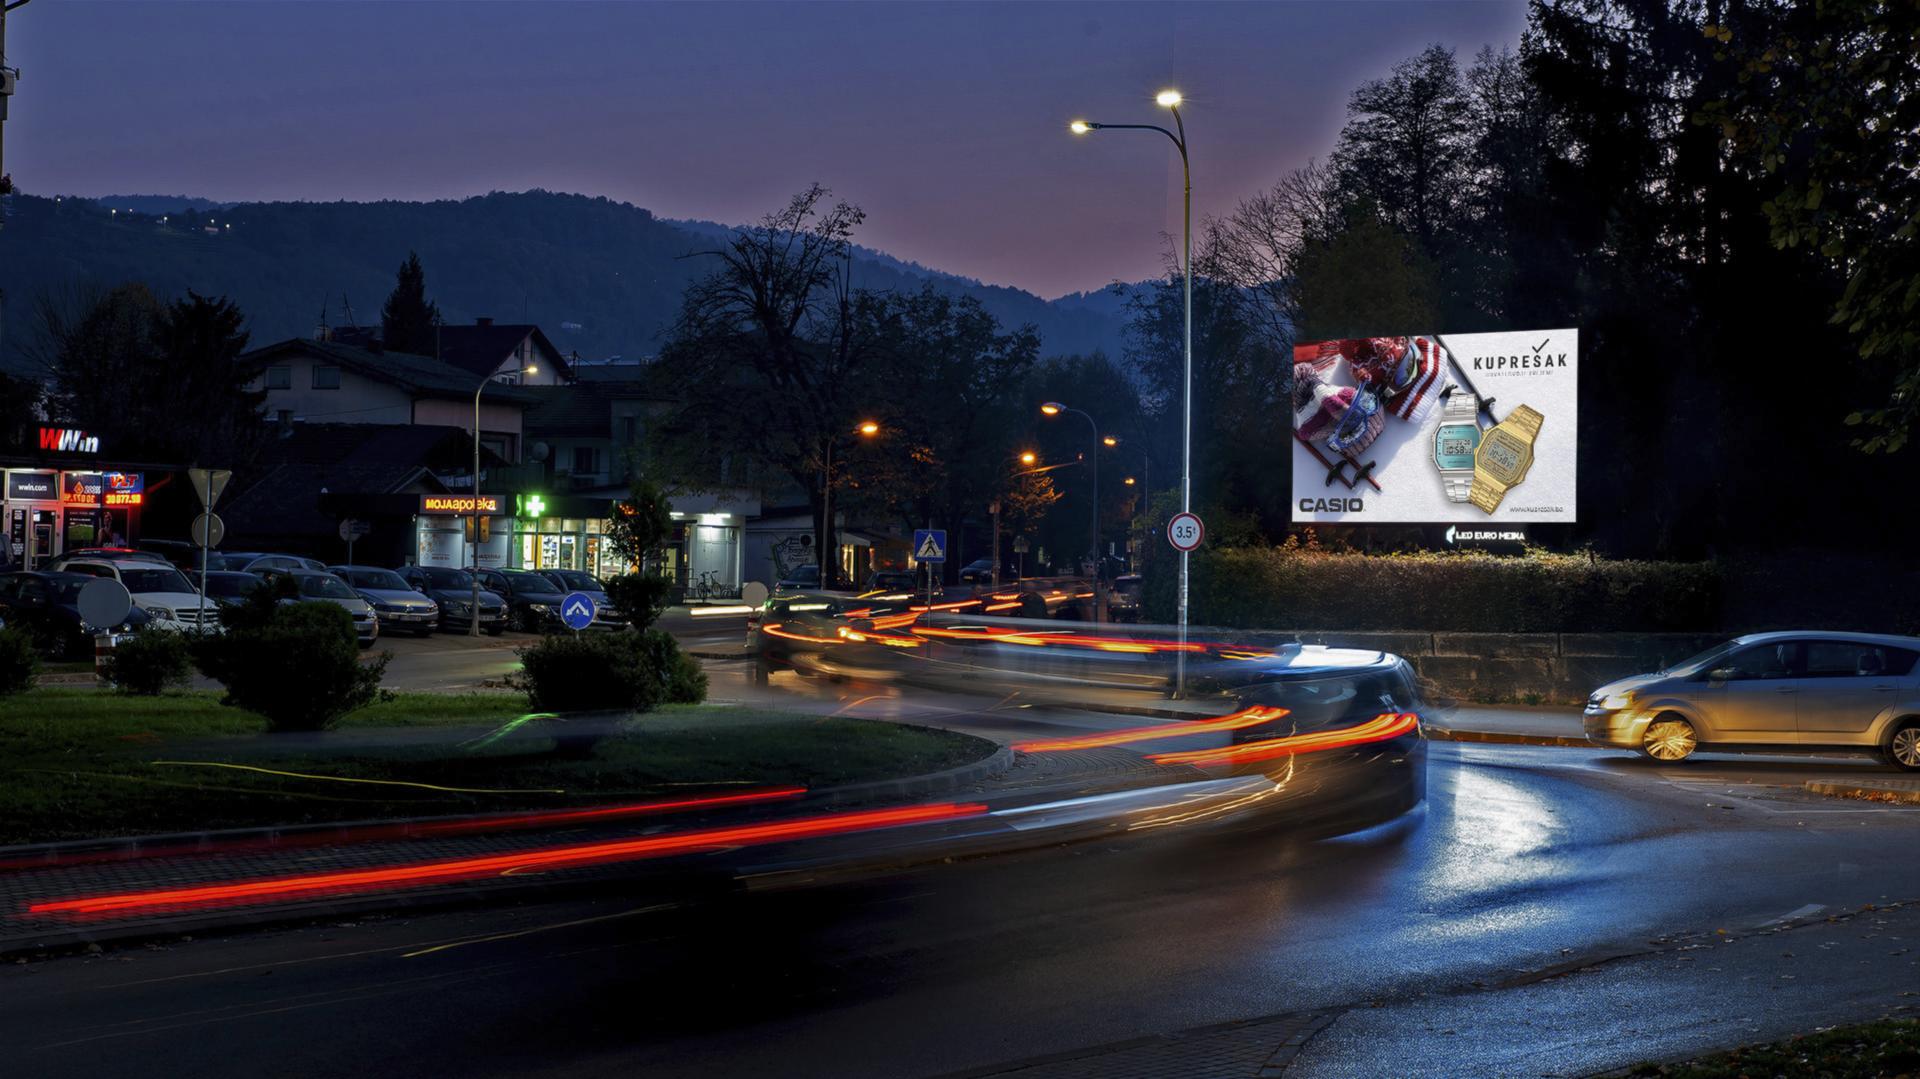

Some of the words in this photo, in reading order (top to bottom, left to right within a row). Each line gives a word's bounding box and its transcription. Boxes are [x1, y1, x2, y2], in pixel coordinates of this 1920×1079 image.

[110, 474, 138, 489] VLT
[18, 484, 47, 492] wwin.com
[1299, 498, 1364, 512] CASIO
[1456, 531, 1473, 540] LED
[1474, 532, 1498, 540] EURO
